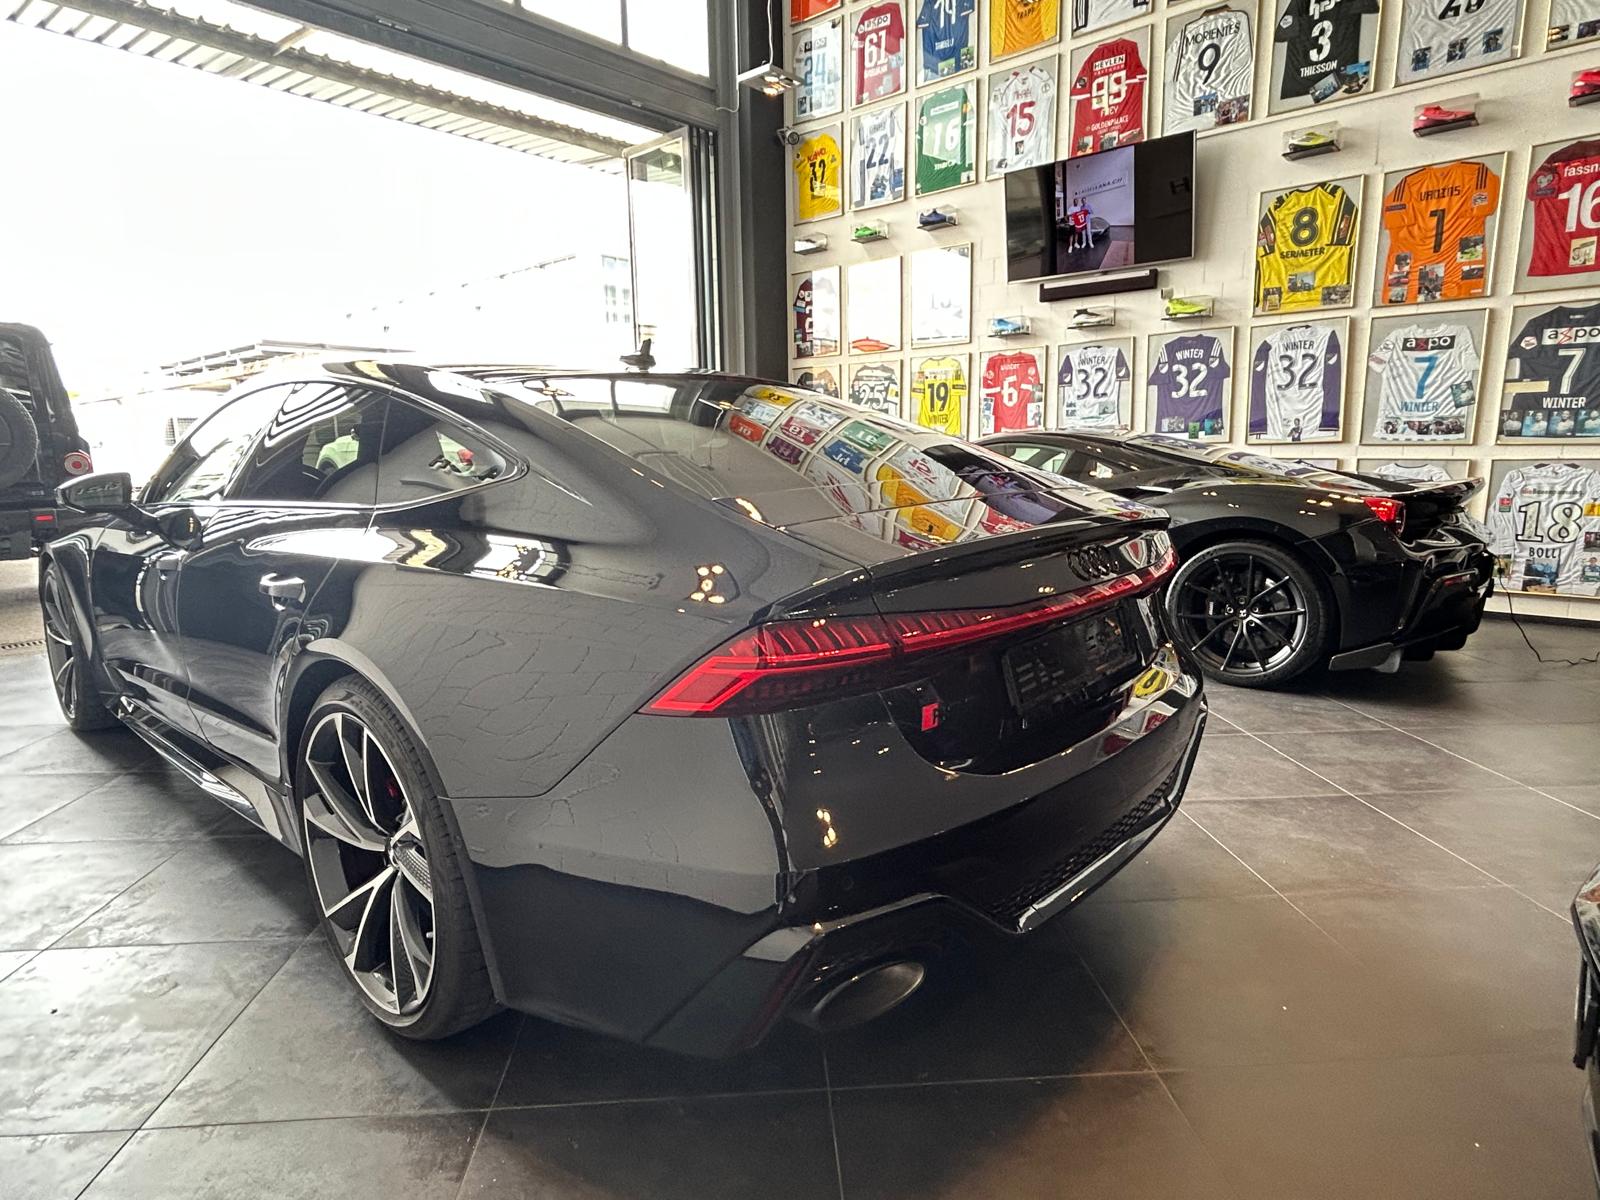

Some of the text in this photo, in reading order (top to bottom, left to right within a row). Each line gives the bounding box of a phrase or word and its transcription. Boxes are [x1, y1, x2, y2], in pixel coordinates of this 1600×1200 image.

[864, 29, 888, 68] 61
[1185, 22, 1241, 47] MORIENTES
[1309, 20, 1333, 62] 3
[1094, 56, 1124, 71] HEYLEN
[1197, 43, 1221, 85] 9
[1300, 60, 1338, 78] THIESSON
[1091, 70, 1127, 116] 99
[933, 117, 960, 155] 16
[1006, 101, 1036, 138] 15
[867, 134, 889, 169] 22
[1563, 162, 1600, 177] fassn
[1558, 180, 1600, 233] 16
[1290, 206, 1319, 248] 8
[1429, 208, 1447, 254] 1
[1080, 354, 1107, 367] WINTER
[1175, 348, 1205, 361] WINTER
[1283, 340, 1316, 352] WINTER
[1077, 367, 1109, 400] 32
[1171, 362, 1209, 399] 32
[1276, 352, 1319, 391] 32
[1413, 355, 1440, 400] 7
[1557, 347, 1587, 395] 7
[859, 382, 886, 411] 25
[927, 382, 949, 412] 19
[1001, 375, 1018, 408] 6
[1400, 401, 1440, 413] WINTER
[1542, 396, 1587, 409] WINTER
[1515, 500, 1583, 543] 18
[1528, 546, 1557, 559] BOLL
